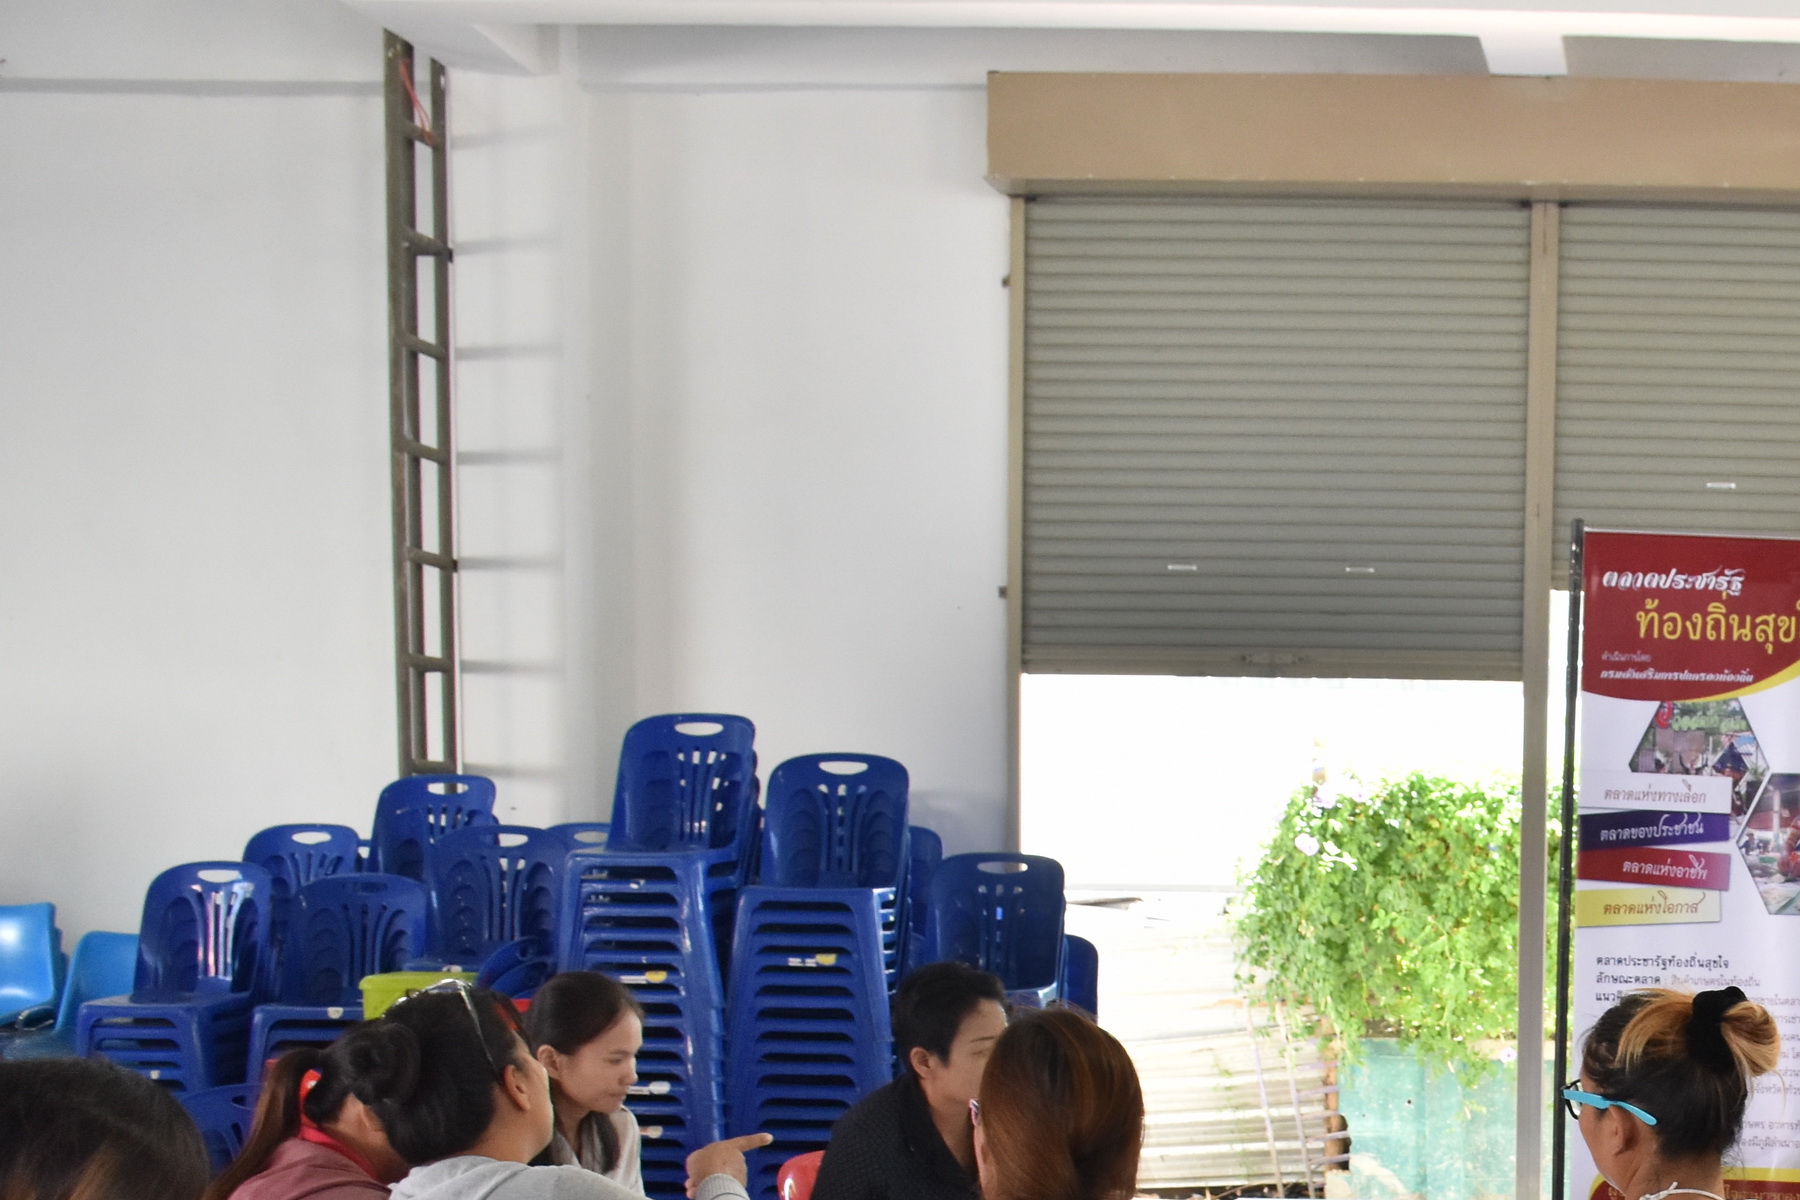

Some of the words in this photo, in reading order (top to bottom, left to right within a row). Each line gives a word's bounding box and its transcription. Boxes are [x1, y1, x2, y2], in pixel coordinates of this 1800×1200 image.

[1603, 565, 1746, 597] ตลาดประชารัฐ
[1600, 812, 1704, 843] ตลาดของประชาชน
[1622, 853, 1708, 881] ตลาดแห่งอาชีพ
[1602, 889, 1707, 916] ตลาดแห่งโอกาส
[1596, 952, 1730, 973] ตลาดประชารัฐท้องถิ่นสุขใจ
